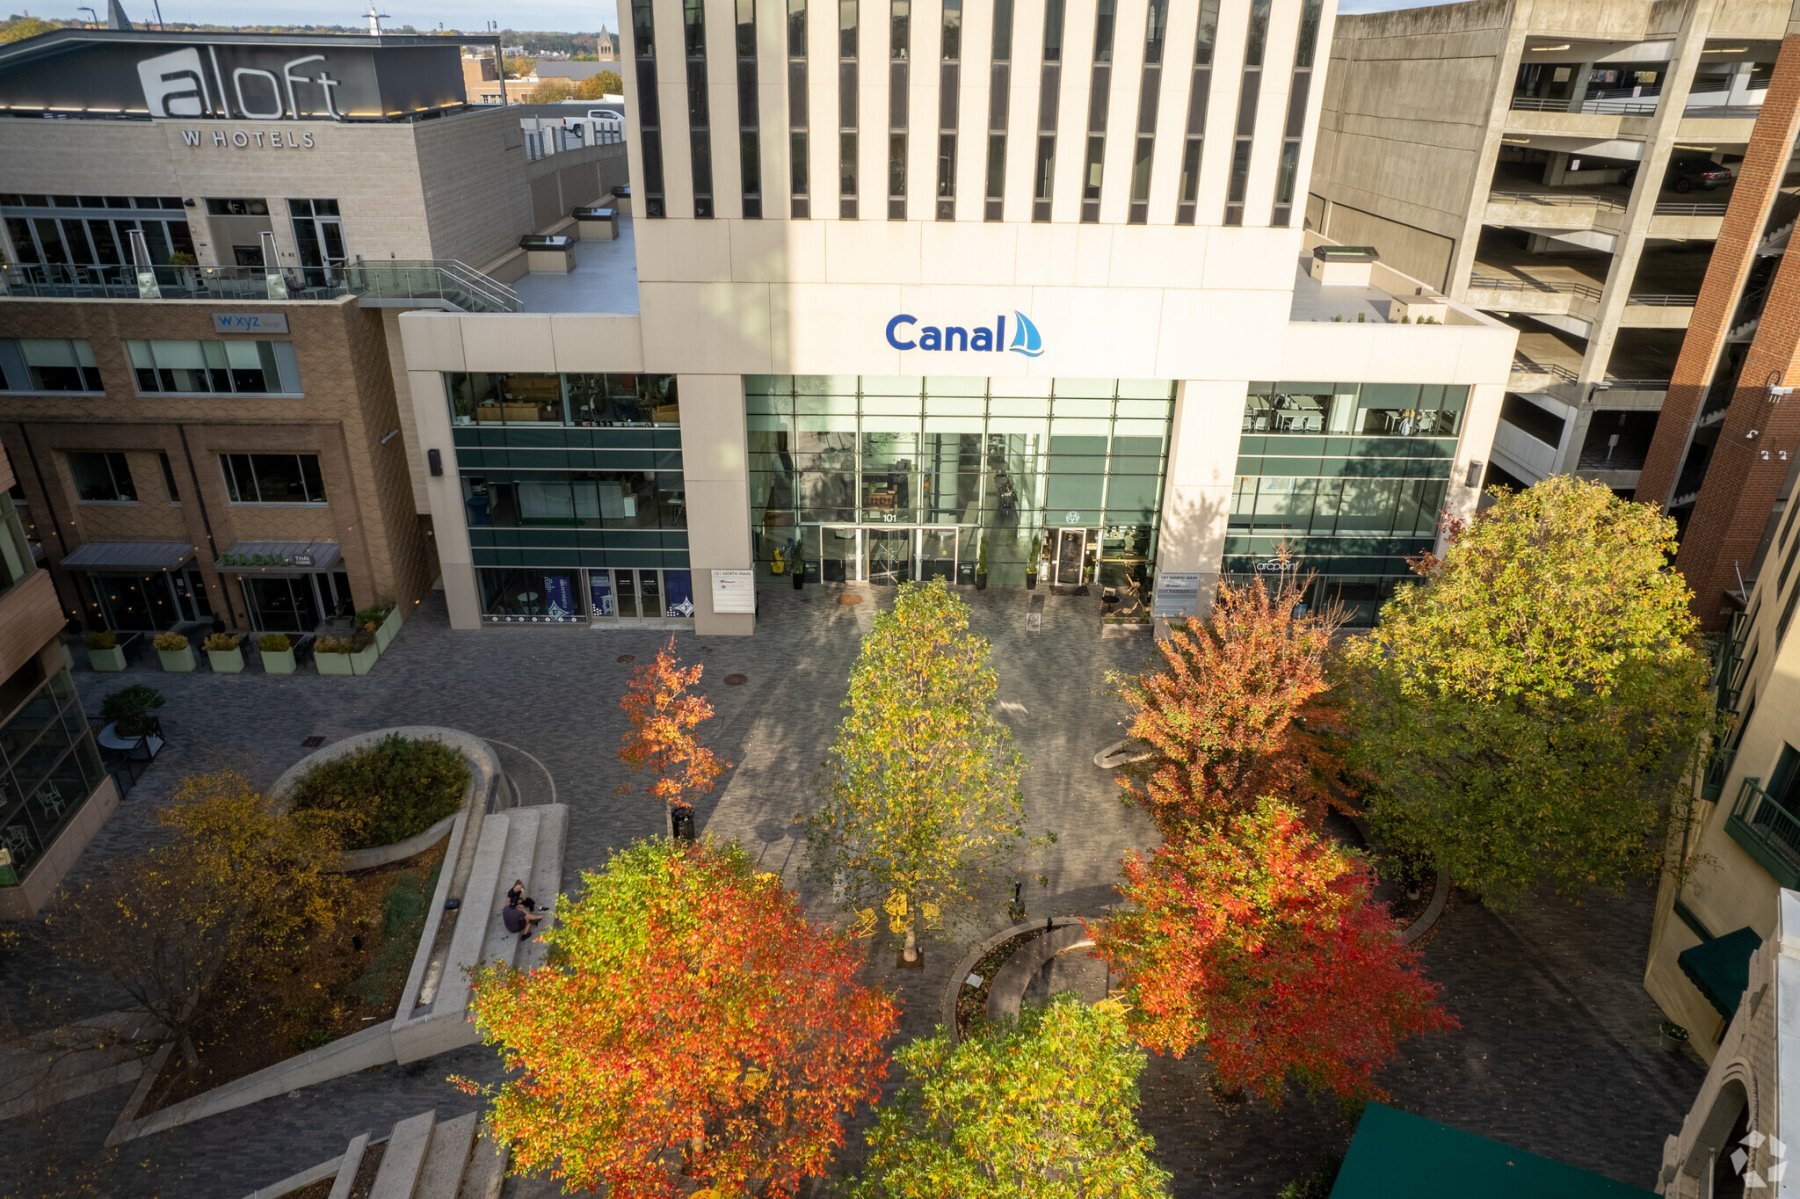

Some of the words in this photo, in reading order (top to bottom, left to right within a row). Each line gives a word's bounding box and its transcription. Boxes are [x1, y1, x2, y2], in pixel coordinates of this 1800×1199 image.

[137, 45, 343, 120] aloft
[181, 130, 201, 147] W
[212, 131, 315, 149] HOTELS
[885, 313, 1006, 352] Canal
[882, 513, 897, 523] 101
